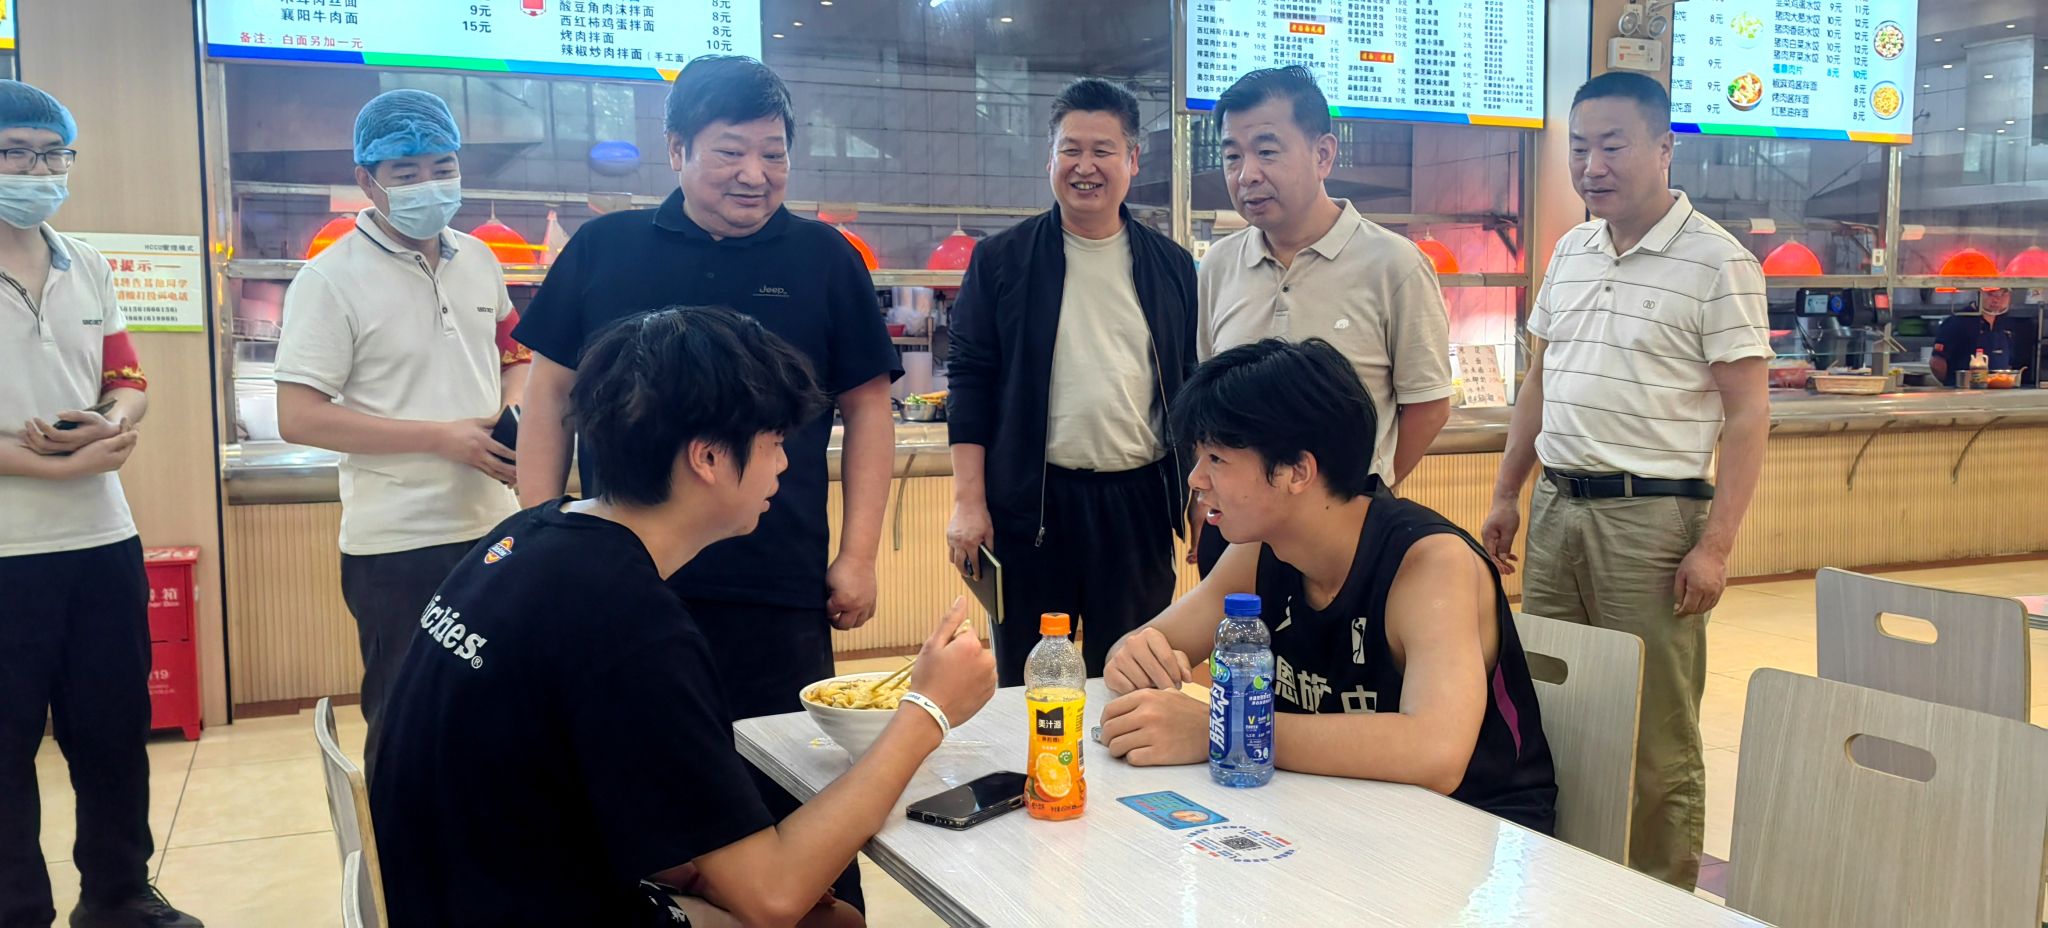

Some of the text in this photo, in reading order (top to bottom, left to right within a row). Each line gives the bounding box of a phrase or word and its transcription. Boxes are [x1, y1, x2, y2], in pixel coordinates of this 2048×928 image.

[470, 5, 491, 17] 9元
[560, 0, 731, 23] 酸豆角肉沫拌面 8元
[1830, 3, 1842, 12] 9元
[281, 8, 491, 33] 襄阳牛肉面 15元
[1710, 14, 1723, 24] 8元
[1828, 16, 1841, 26] 10元
[1855, 19, 1869, 28] 12元
[560, 14, 732, 37] 西红柿鸡蛋拌面 8元
[560, 30, 732, 51] 烤肉拌面 10元
[1827, 30, 1841, 39] 10元
[1855, 32, 1868, 41] 12元
[1709, 36, 1722, 46] 8元
[562, 45, 642, 59] 辣椒炒肉拌面
[1827, 43, 1841, 53] 10元
[1855, 45, 1868, 55] 12元
[1708, 59, 1721, 68] 9元
[1826, 55, 1840, 64] 10元
[1854, 57, 1868, 67] 12元
[1853, 70, 1867, 80] 10元
[1708, 81, 1720, 91] 9元
[1854, 85, 1866, 94] 8元
[1854, 98, 1865, 108] 8元
[1707, 104, 1720, 114] 9元
[1853, 111, 1865, 121] 8元
[1038, 719, 1062, 729] 美汁源
